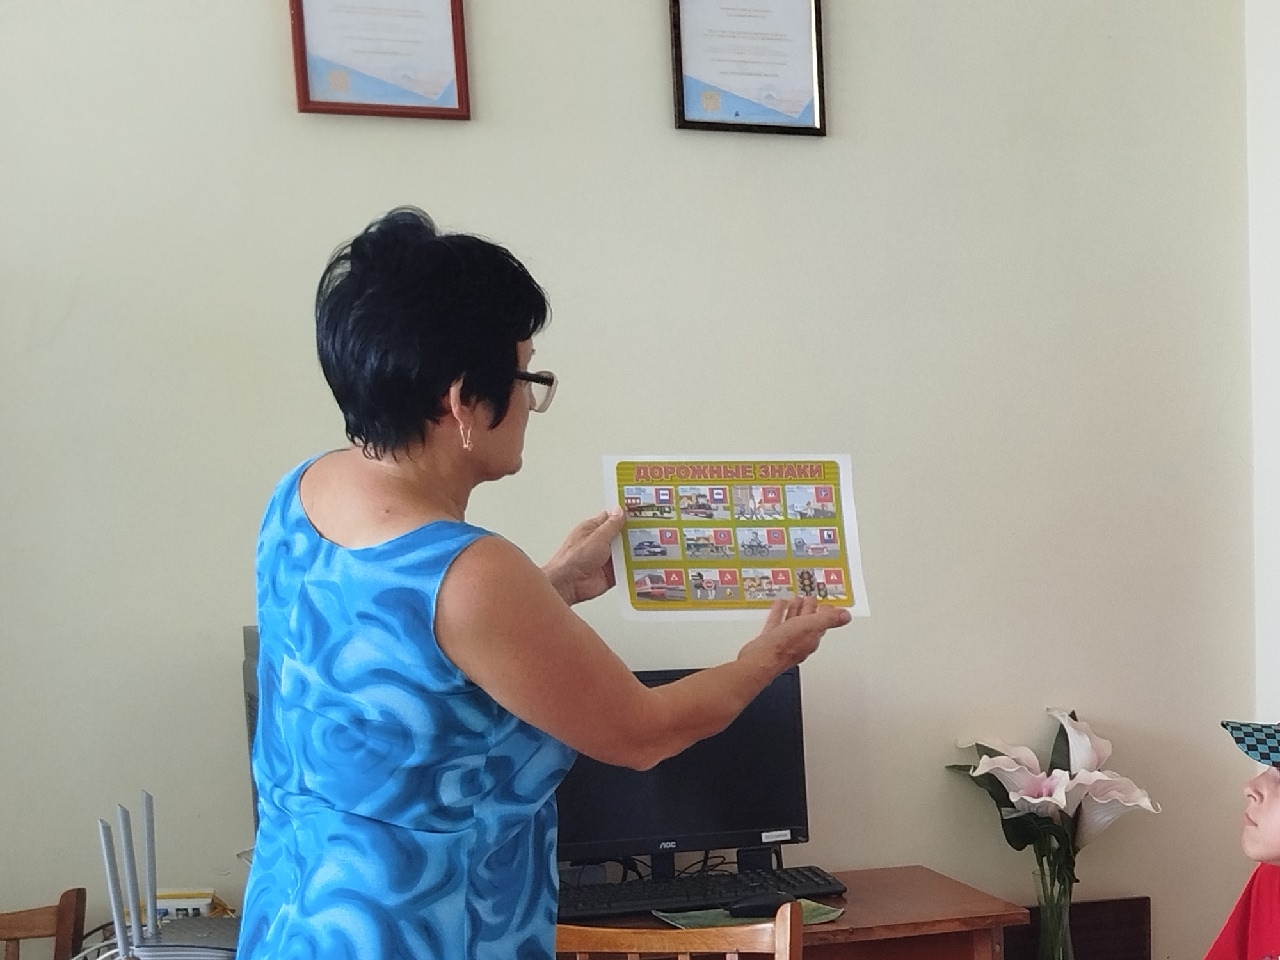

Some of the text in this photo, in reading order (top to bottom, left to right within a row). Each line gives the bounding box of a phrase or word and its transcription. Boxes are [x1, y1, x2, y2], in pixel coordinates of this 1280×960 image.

[634, 463, 825, 483] ДОРОЖНЫЕ ЗНАКИ
[660, 841, 677, 850] AOC
